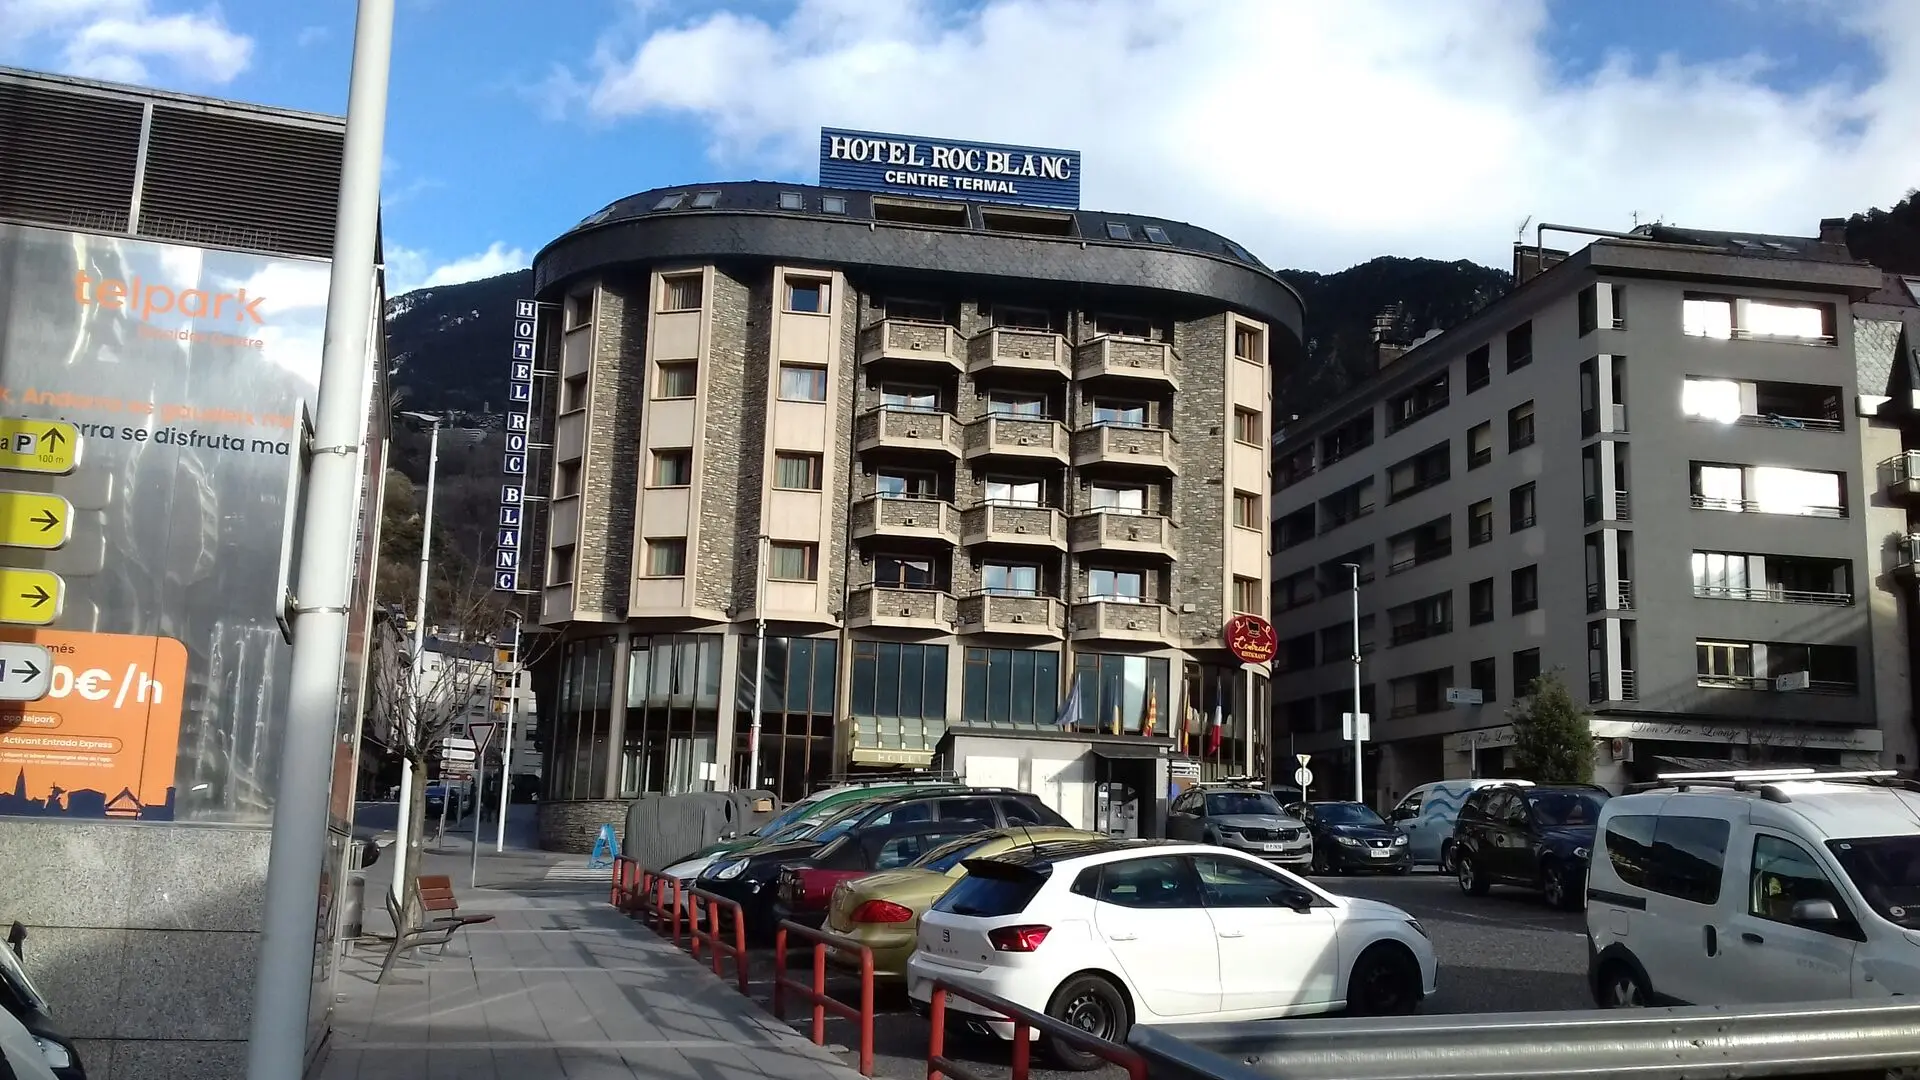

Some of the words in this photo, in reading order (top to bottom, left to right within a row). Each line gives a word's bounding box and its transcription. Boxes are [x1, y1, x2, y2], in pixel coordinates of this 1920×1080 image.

[830, 136, 924, 166] HOTEL
[931, 146, 981, 172] ROC
[986, 151, 1071, 180] BLANC
[885, 170, 949, 188] CENTRE
[953, 176, 1018, 194] TERMAL
[73, 269, 266, 325] telpark
[514, 301, 534, 399] HOTEL
[38, 454, 54, 464] 100
[121, 426, 148, 442] se
[154, 427, 245, 452] disfruta
[509, 414, 524, 471] ROC
[500, 487, 519, 589] BLANC
[3, 736, 42, 746] Activant
[42, 738, 78, 747] Entrada
[79, 739, 113, 750] Express
